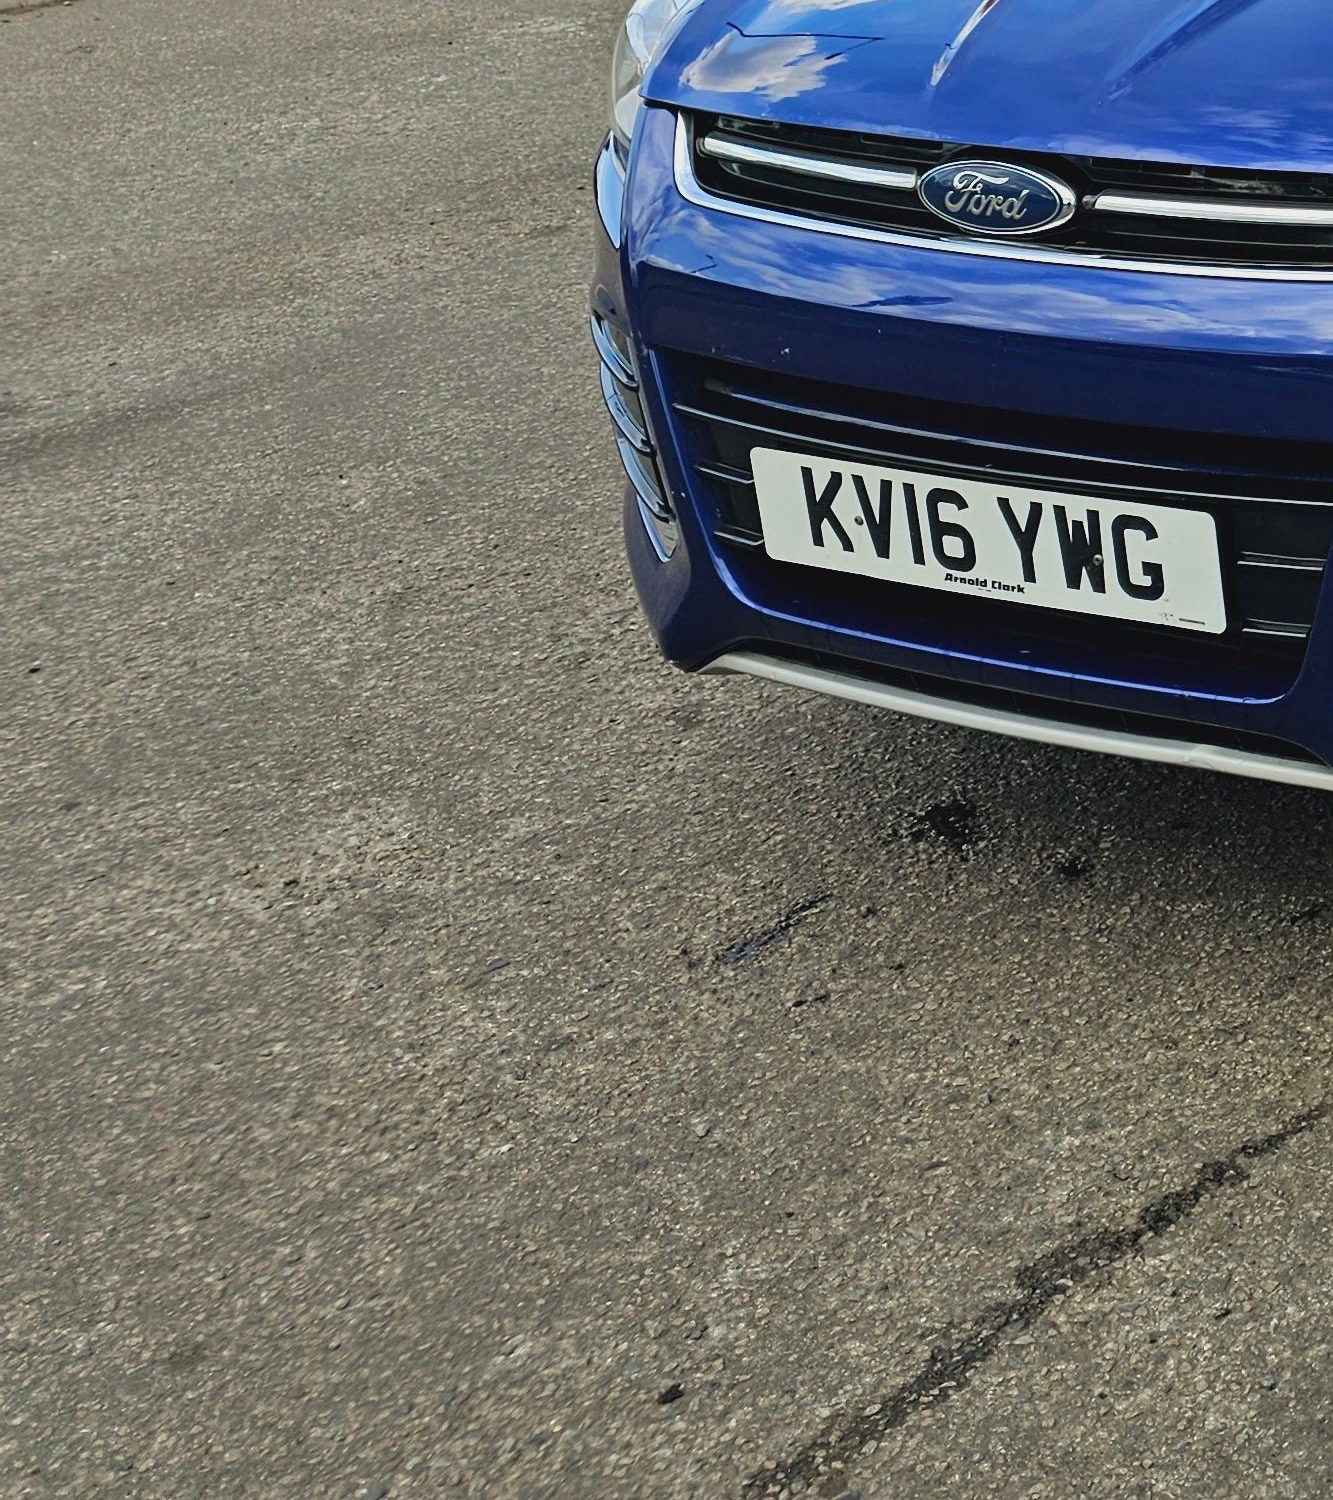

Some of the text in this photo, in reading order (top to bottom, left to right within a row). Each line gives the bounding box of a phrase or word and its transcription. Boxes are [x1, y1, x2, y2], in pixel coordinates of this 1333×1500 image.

[945, 170, 1031, 220] Ford
[801, 465, 1165, 601] KV16 YWG
[944, 572, 1026, 594] Arnold Clark
